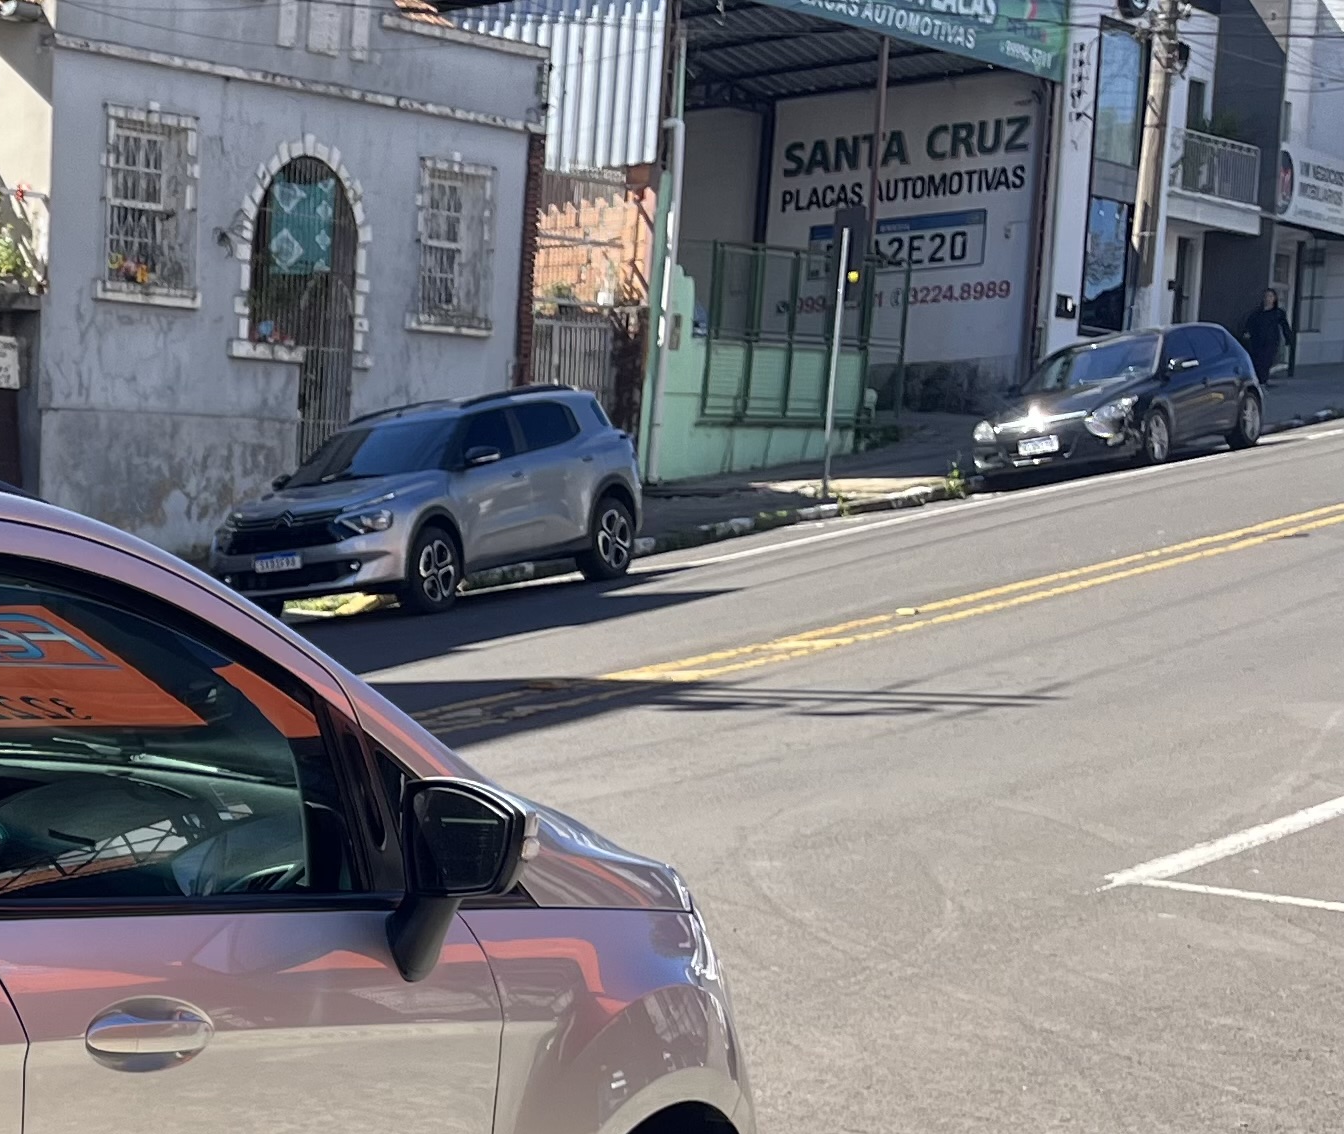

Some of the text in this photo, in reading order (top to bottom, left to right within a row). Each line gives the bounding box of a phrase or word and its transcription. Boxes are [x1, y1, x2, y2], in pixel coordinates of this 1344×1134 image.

[861, 5, 977, 50] AUTOMOTIVAS
[783, 115, 1031, 178] SANTA CRUZ
[780, 164, 1026, 213] PLACAS AUTOMOTIVAS
